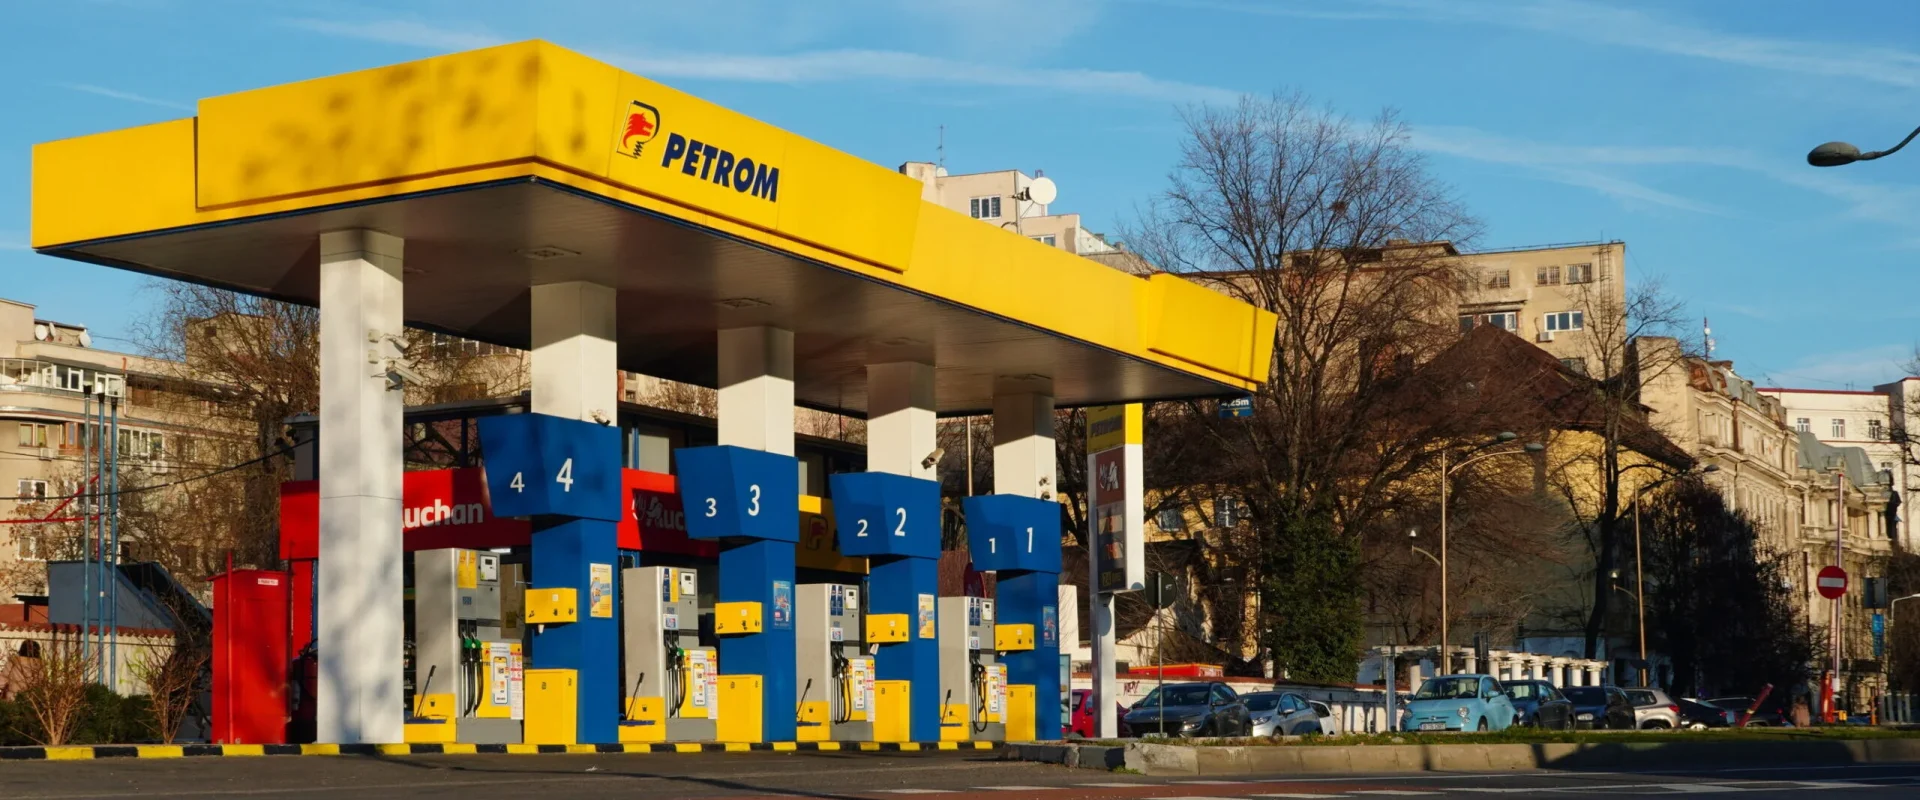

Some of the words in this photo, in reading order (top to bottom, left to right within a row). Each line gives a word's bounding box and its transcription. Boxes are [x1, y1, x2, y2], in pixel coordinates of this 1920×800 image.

[661, 132, 780, 203] PETROM
[510, 472, 525, 493] 4
[556, 458, 574, 492] 4
[403, 499, 484, 528] uchan
[705, 497, 717, 518] 3
[747, 484, 761, 517] 3
[857, 519, 868, 537] 2
[894, 507, 907, 537] 2
[988, 537, 996, 554] 1
[1026, 527, 1034, 553] 1
